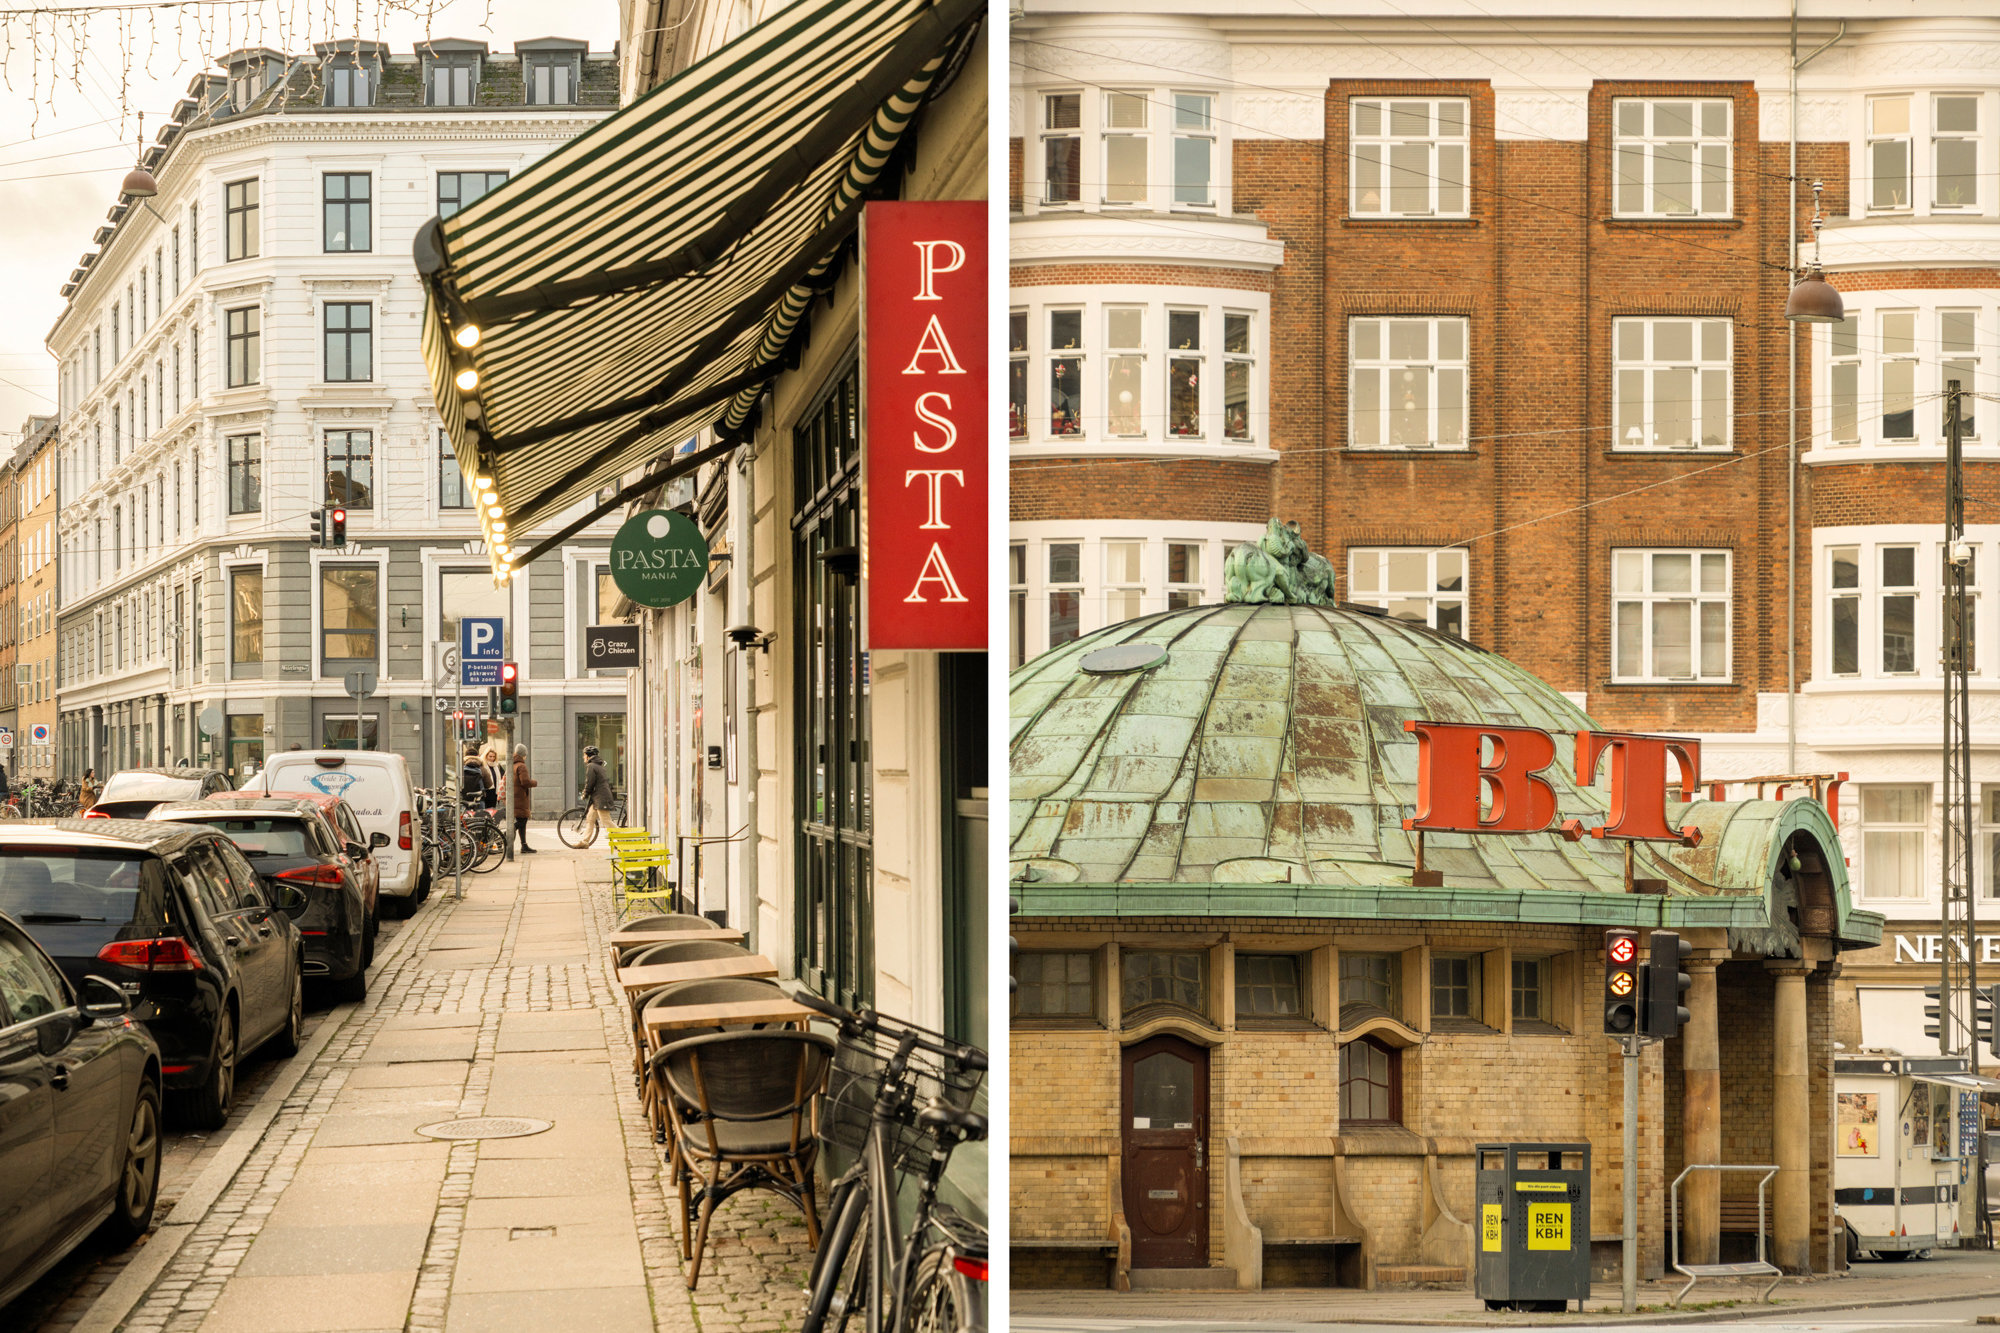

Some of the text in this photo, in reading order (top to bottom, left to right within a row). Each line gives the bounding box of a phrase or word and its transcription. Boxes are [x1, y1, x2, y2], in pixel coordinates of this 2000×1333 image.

[902, 239, 969, 602] PASTA
[617, 549, 701, 569] PASTA
[642, 572, 677, 580] MANIA
[471, 623, 494, 655] P
[453, 700, 485, 708] YSKE
[1486, 1214, 1499, 1226] REN
[1536, 1213, 1563, 1224] REN
[1486, 1229, 1499, 1240] KBH
[1536, 1228, 1563, 1239] KBH
